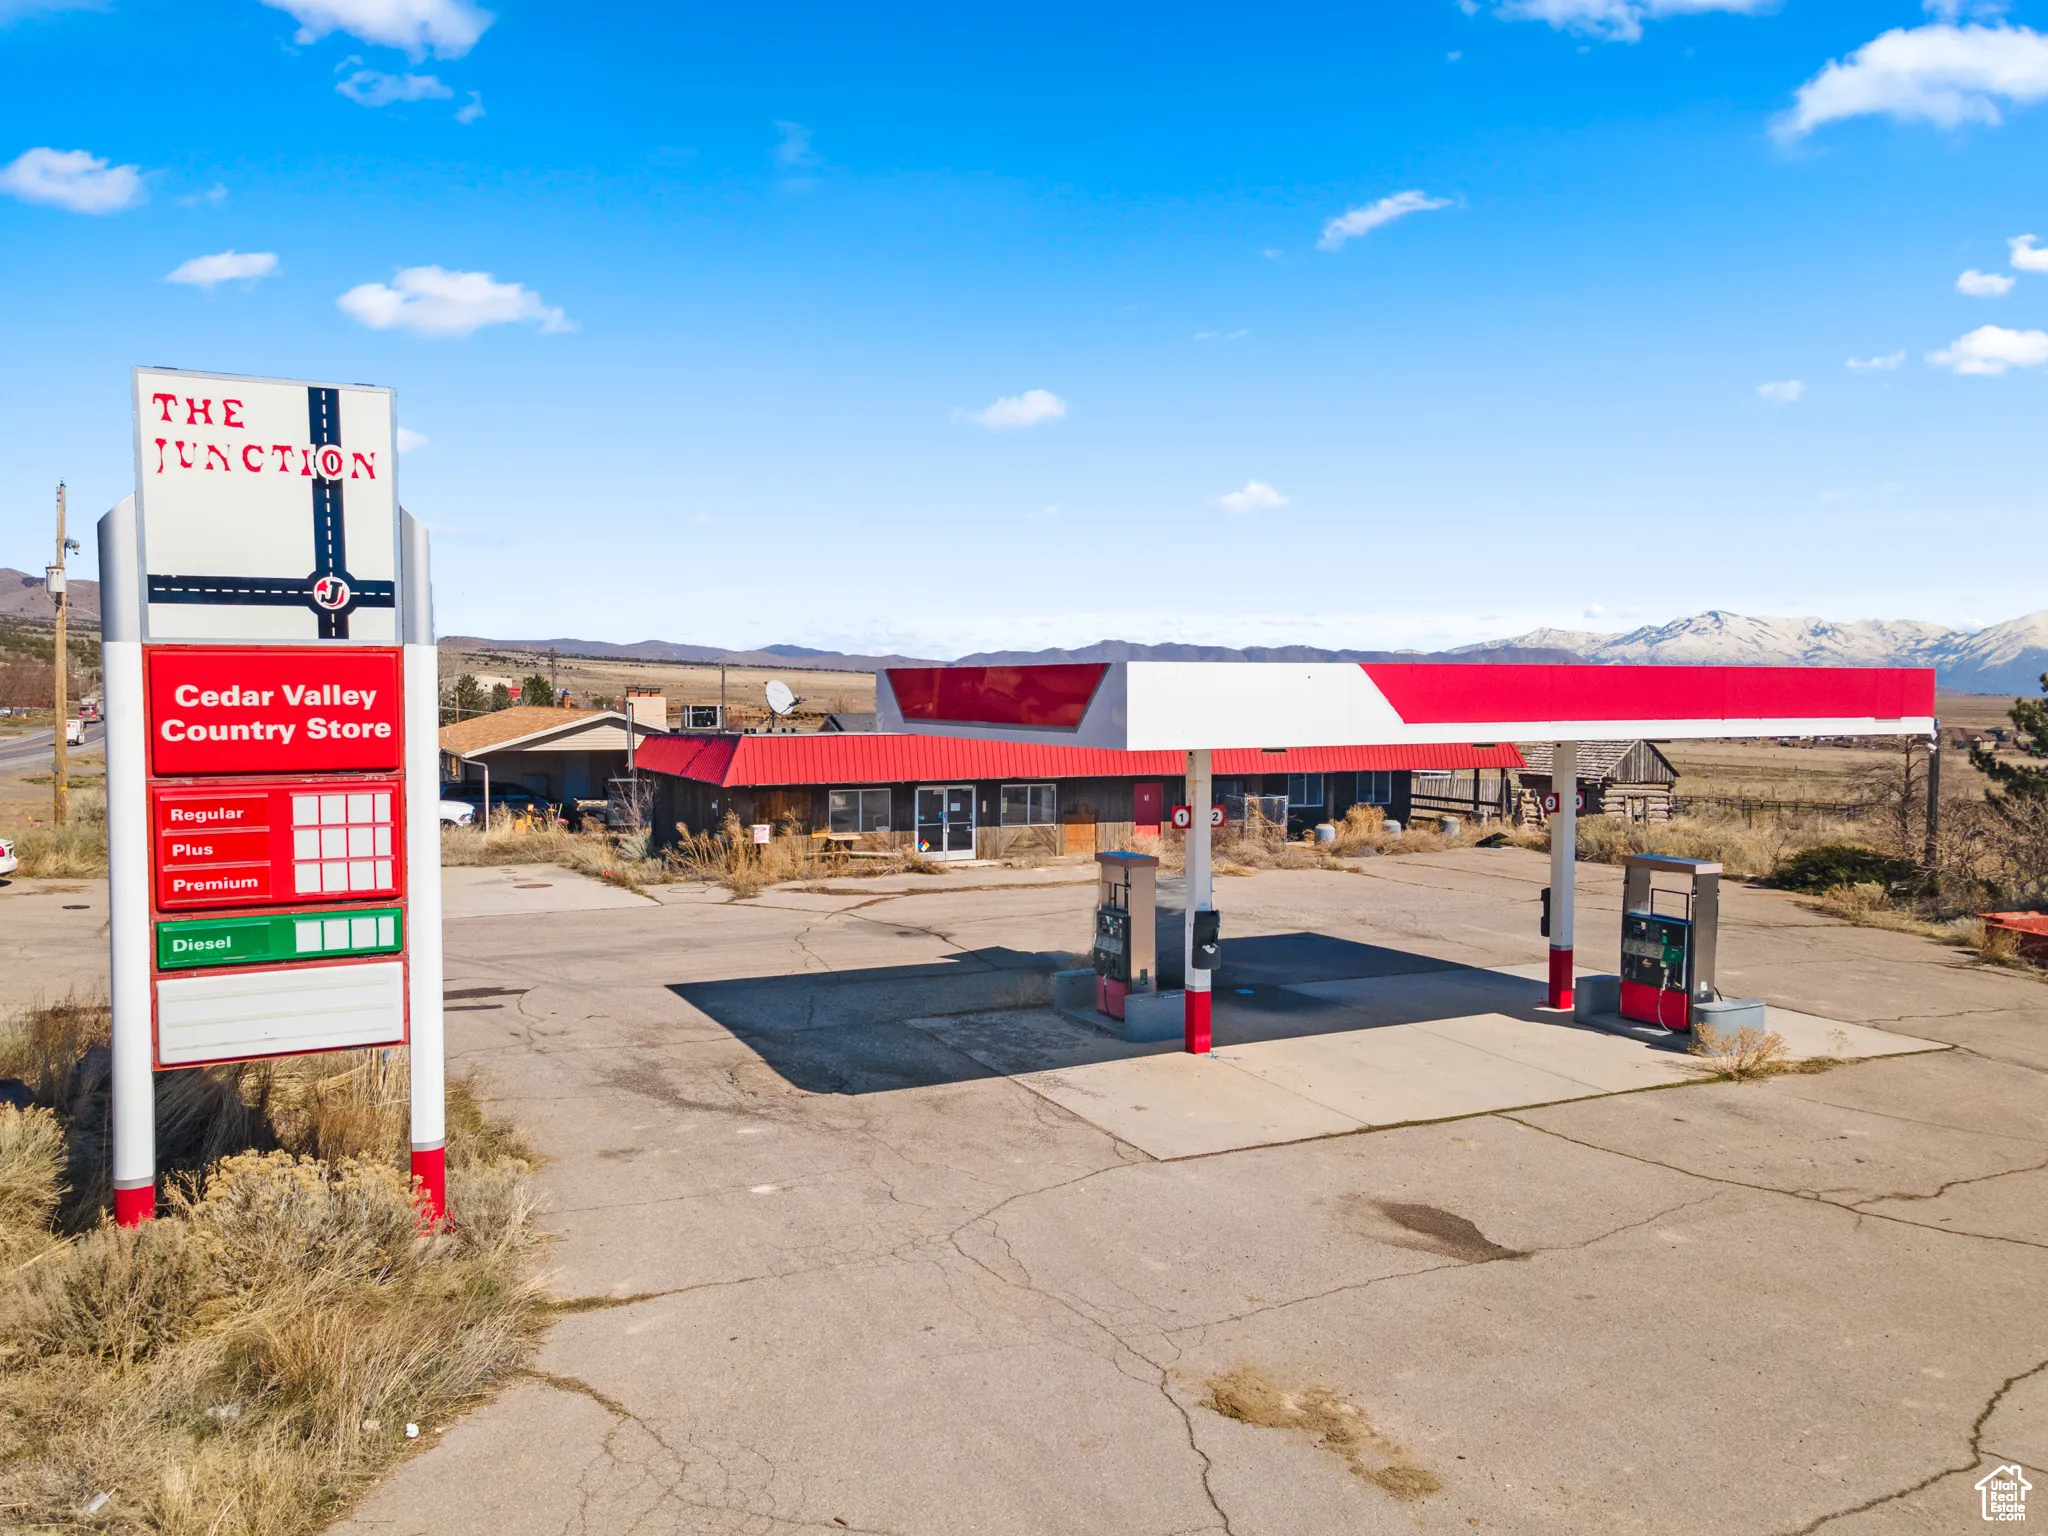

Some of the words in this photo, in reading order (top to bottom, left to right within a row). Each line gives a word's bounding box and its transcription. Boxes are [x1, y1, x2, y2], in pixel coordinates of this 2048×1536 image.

[152, 393, 245, 429] THE
[155, 438, 376, 480] JUNCTION
[174, 684, 275, 707] Cedar
[281, 684, 377, 711] Valley
[160, 718, 297, 745] Country
[306, 717, 392, 740] Store
[1548, 798, 1554, 808] 3
[170, 807, 244, 824] Regular
[1179, 813, 1184, 823] 1
[1212, 812, 1219, 822] 2
[172, 843, 214, 857] Plus
[173, 876, 259, 892] Premium
[172, 936, 232, 952] Diesel
